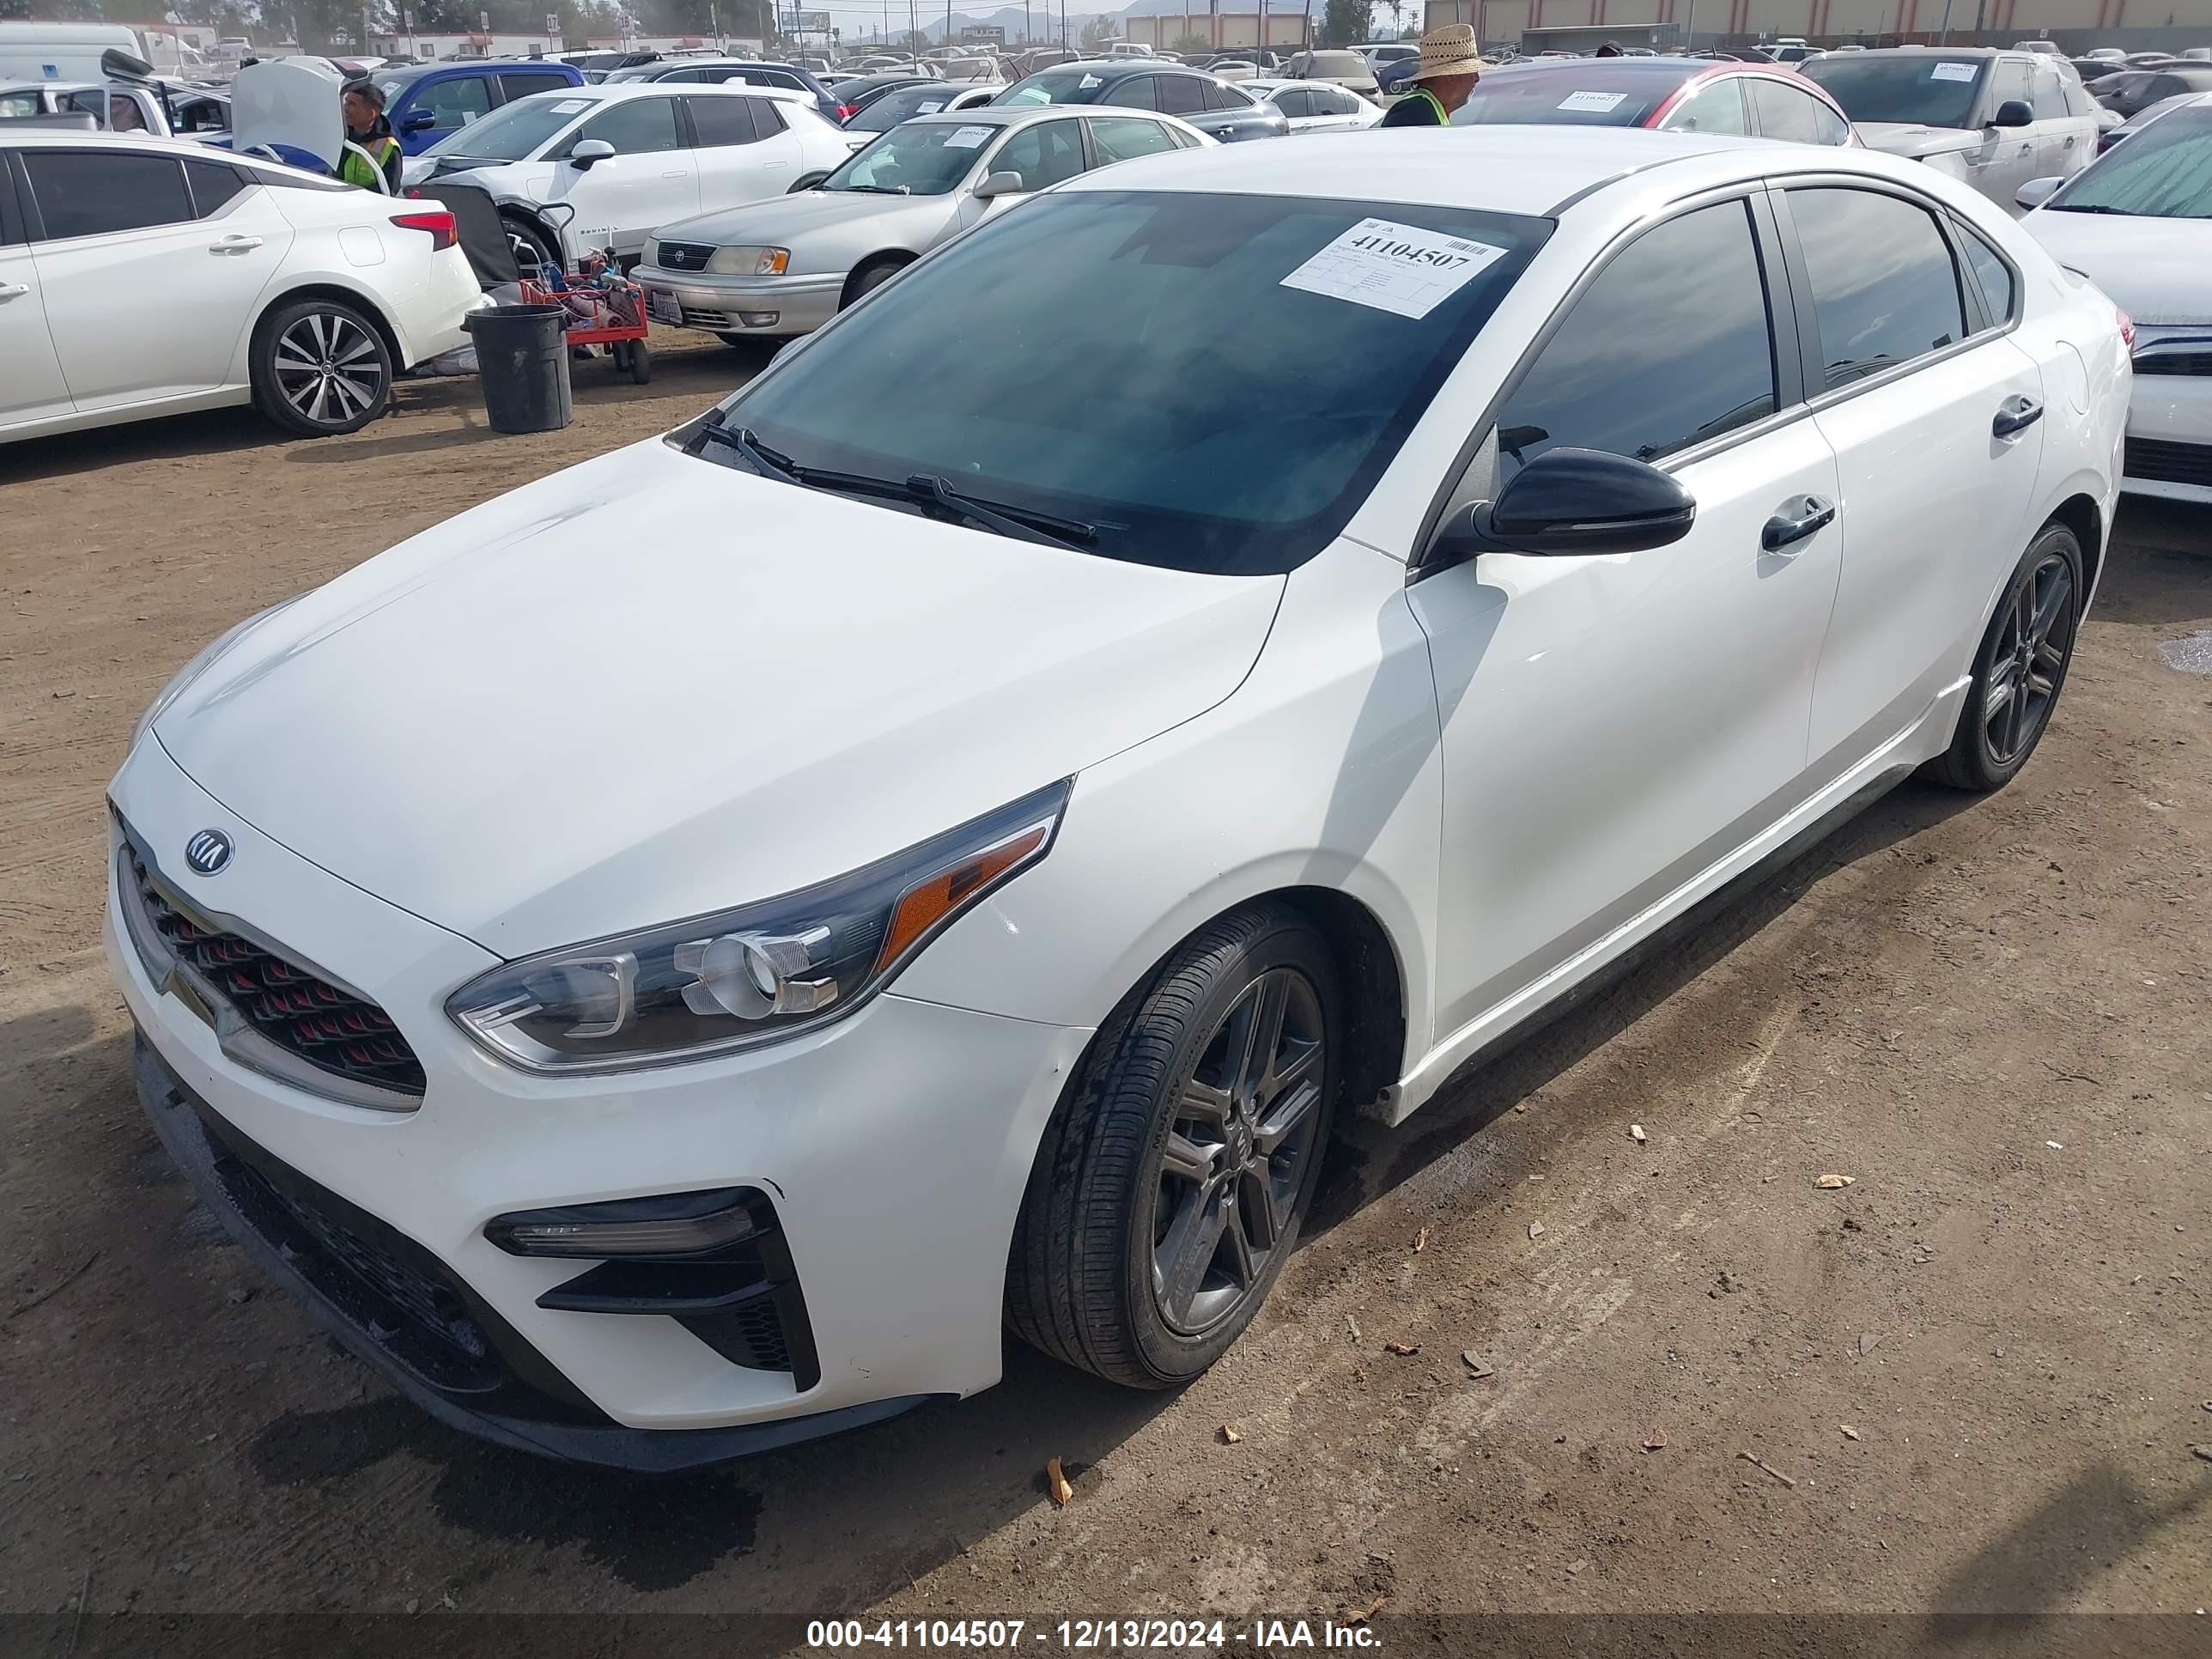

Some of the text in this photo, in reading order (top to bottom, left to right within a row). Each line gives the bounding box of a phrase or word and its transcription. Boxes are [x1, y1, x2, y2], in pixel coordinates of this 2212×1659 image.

[548, 17, 557, 29] 17
[621, 16, 629, 28] 16
[1351, 234, 1471, 270] 41104507
[188, 831, 224, 870] KIA
